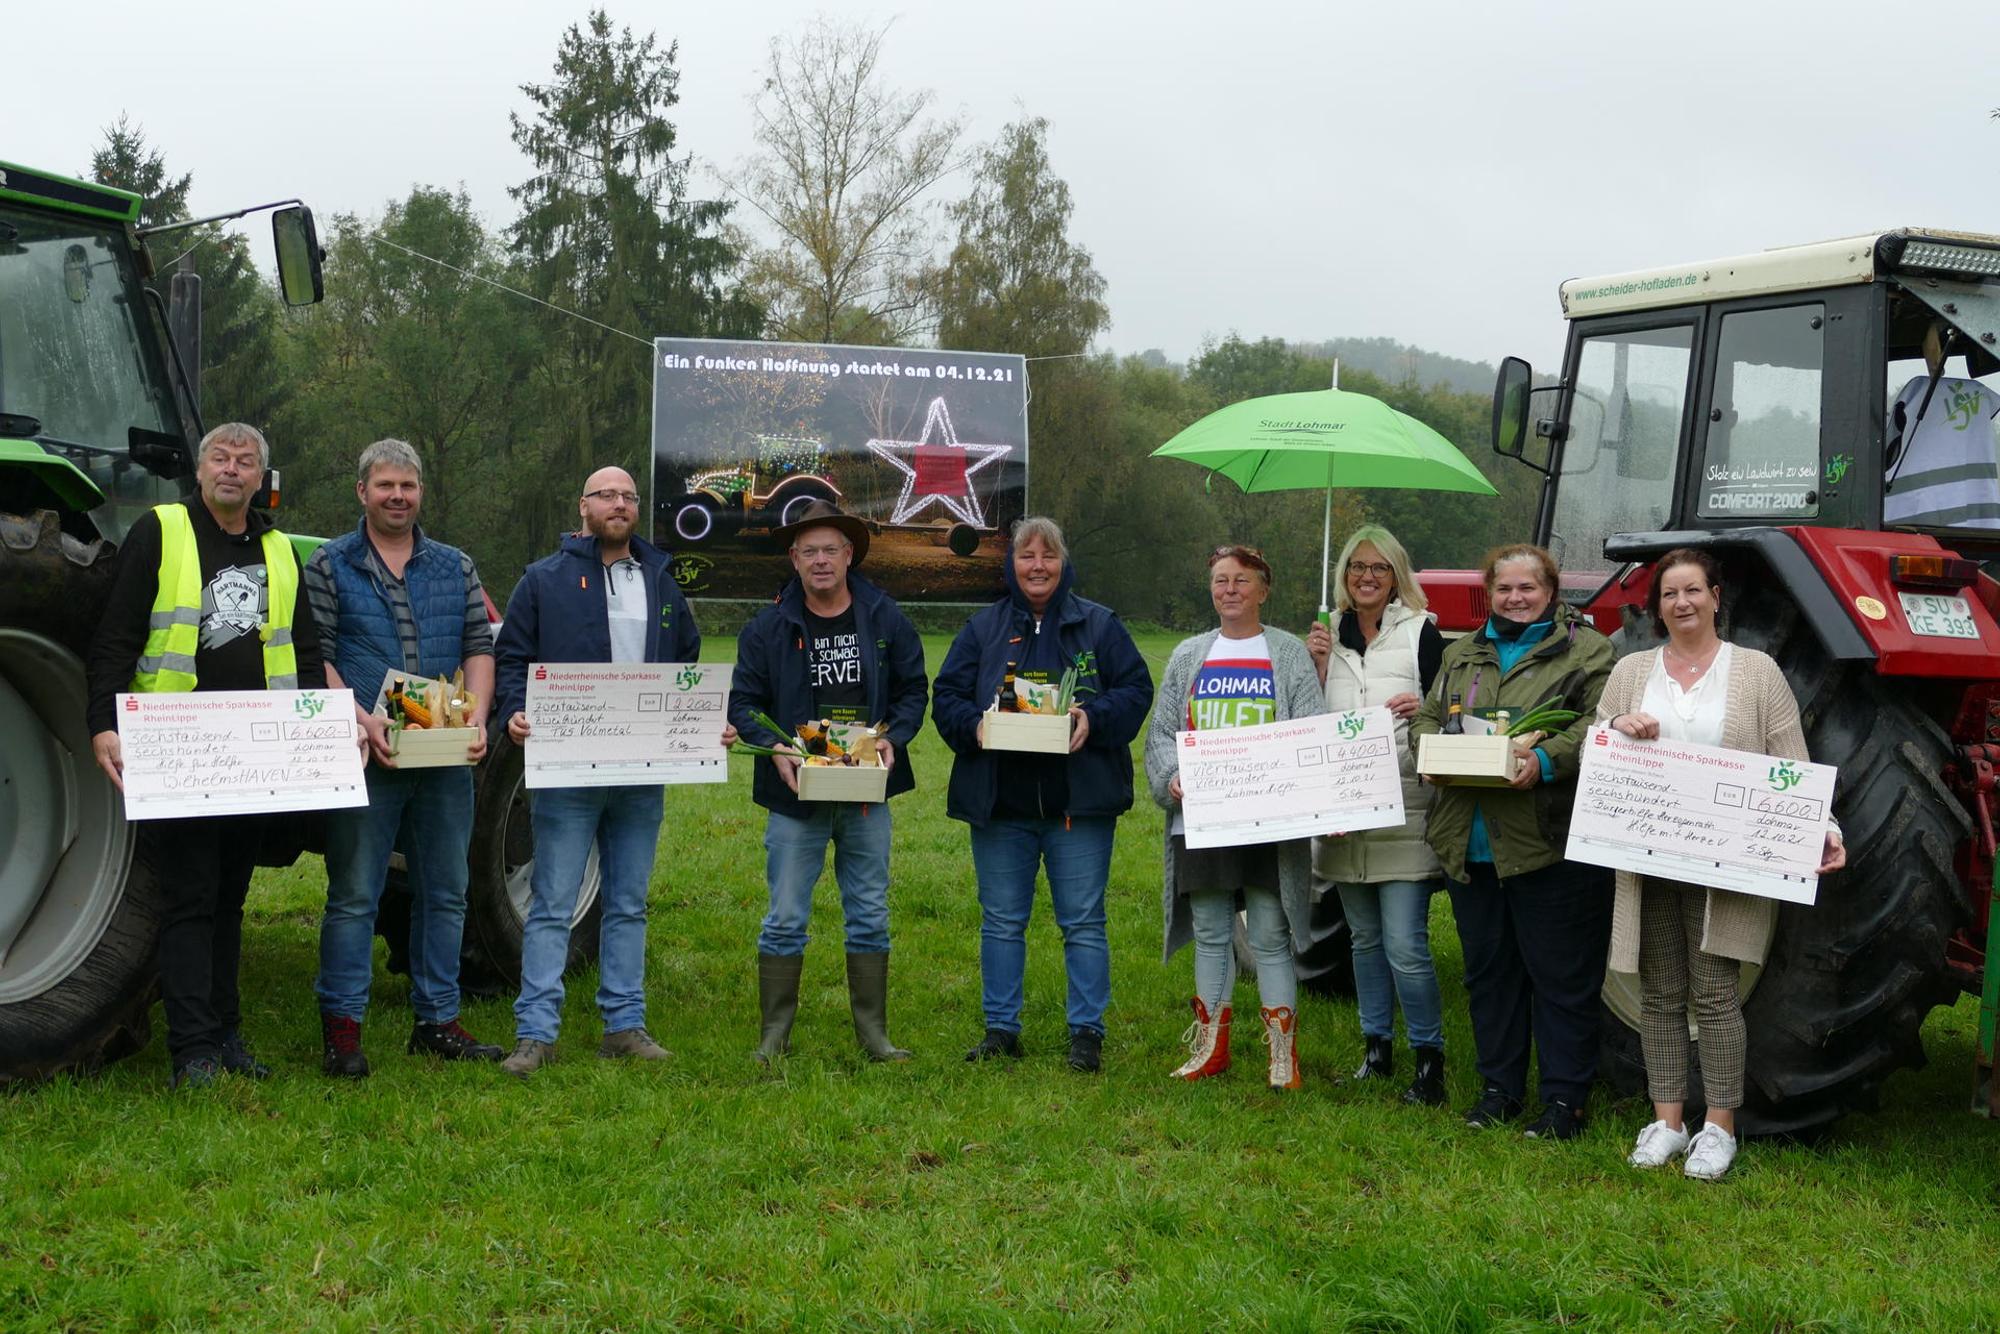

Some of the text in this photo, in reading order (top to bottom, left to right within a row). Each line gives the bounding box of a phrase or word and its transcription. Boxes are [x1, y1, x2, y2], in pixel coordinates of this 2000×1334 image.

[664, 354, 1013, 382] Ein Funken Hoffnung startet am 04.12.21
[1259, 419, 1345, 430] Stadt Lohmar
[1707, 462, 1818, 481] Stolz ein Landwirt zu sein
[216, 581, 258, 597] HARTMANNS
[1924, 597, 1950, 614] SU
[1909, 615, 1975, 635] KE 393
[550, 672, 661, 681] Niederrheinische Sparkasse
[811, 660, 861, 686] ERVE
[549, 683, 595, 691] RheinLippe
[1198, 677, 1271, 695] LOHMAR
[143, 700, 272, 711] Niederrheinische Sparkasse
[143, 715, 198, 723] RheinLippe
[1197, 701, 1272, 730] HILFT
[1200, 726, 1316, 746] Niederrheinische Sparkasse
[1200, 747, 1248, 756] RheinLippe
[1610, 751, 1664, 769] RheinLippe
[1611, 739, 1745, 771] Niederrheinische Sparkasse
